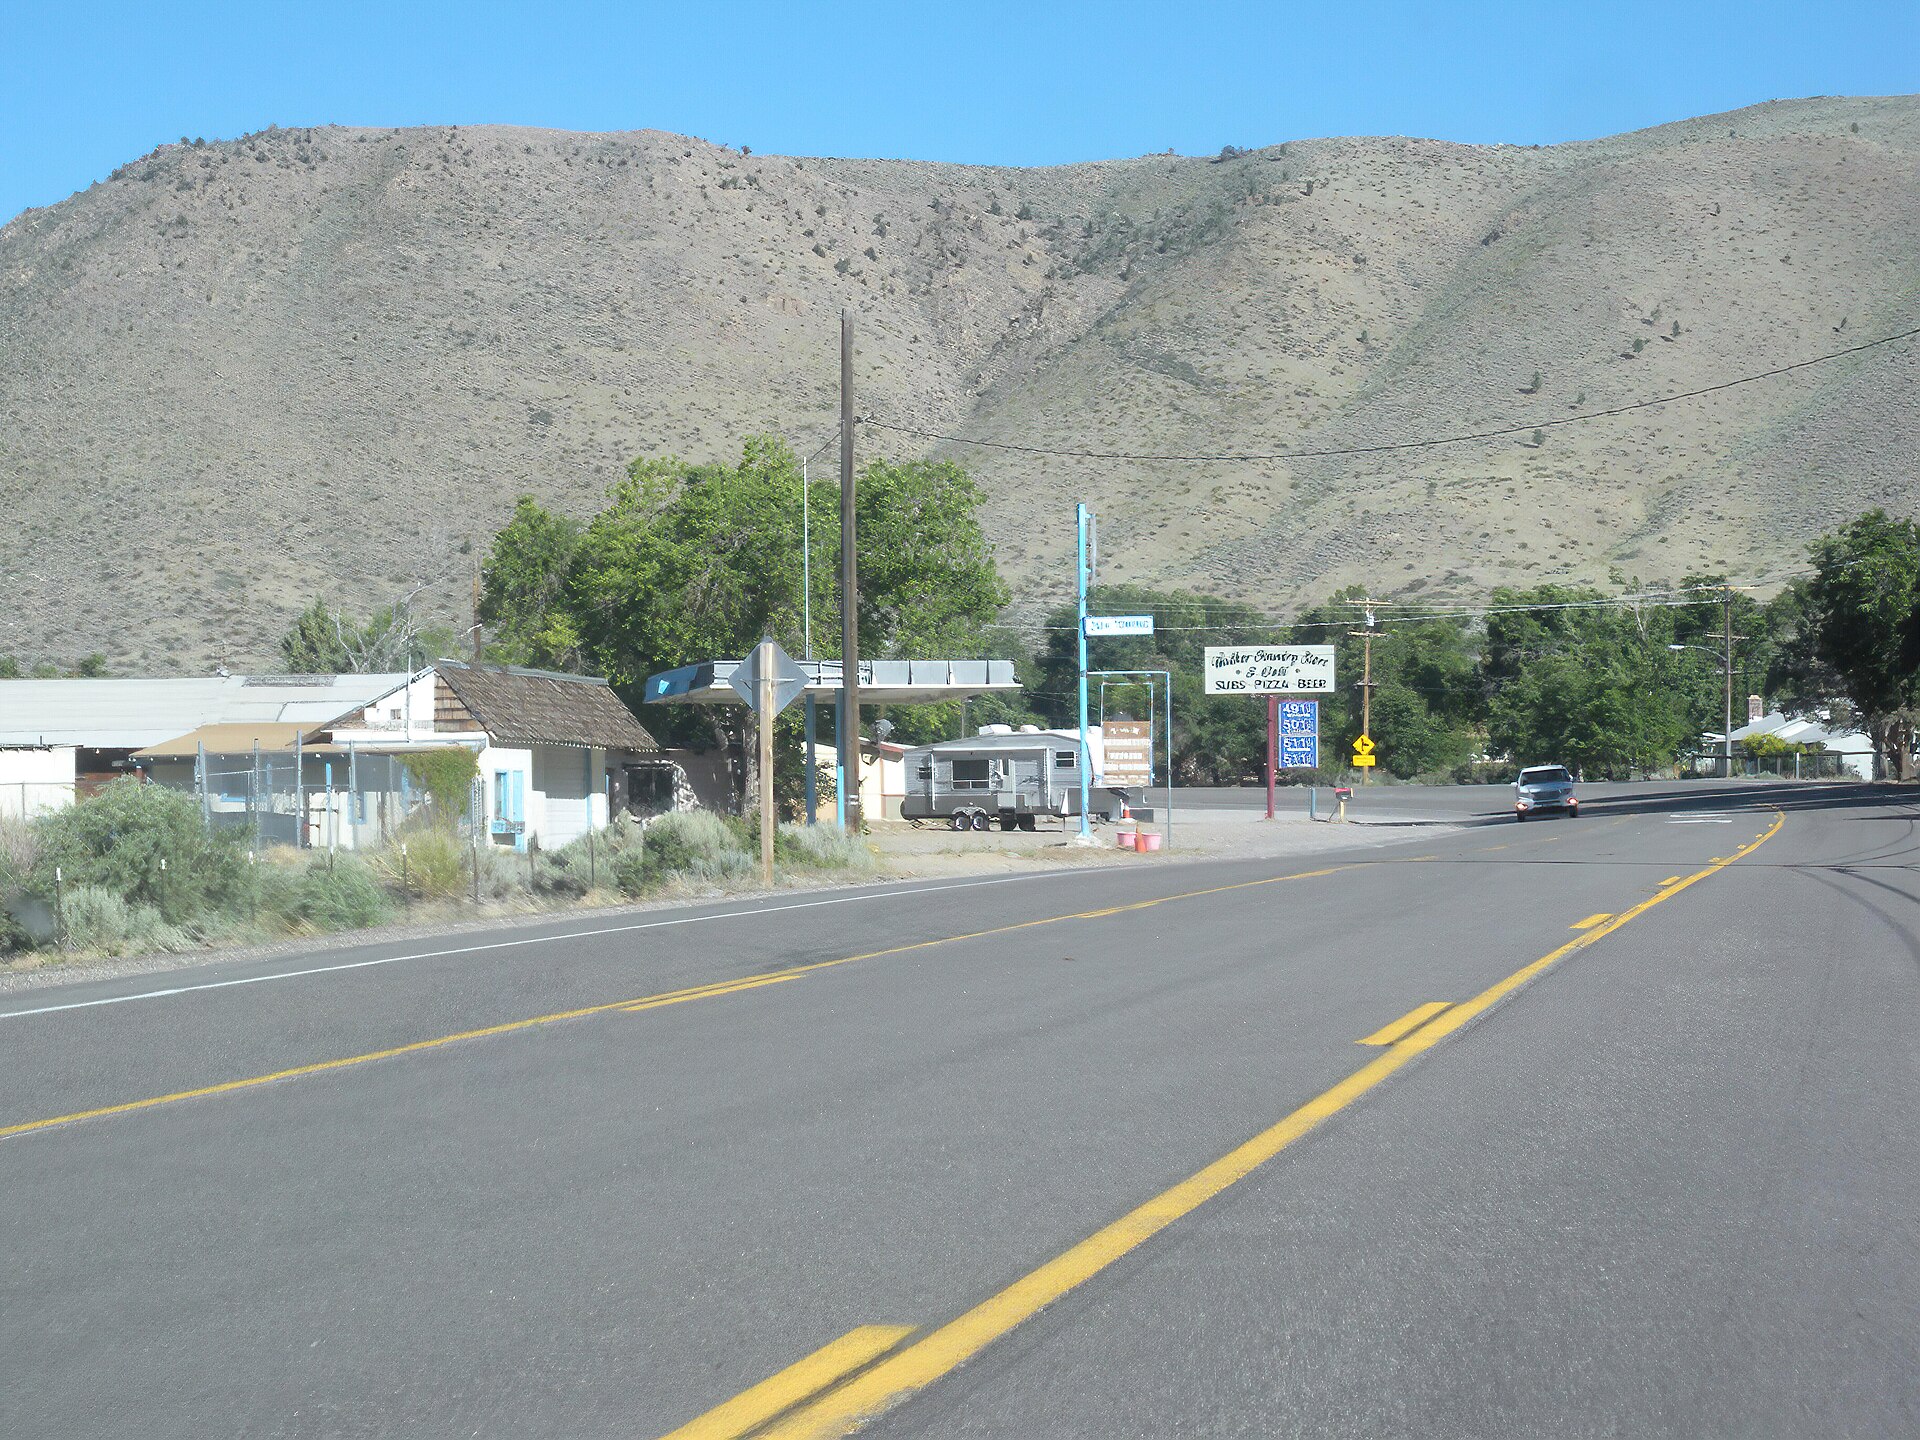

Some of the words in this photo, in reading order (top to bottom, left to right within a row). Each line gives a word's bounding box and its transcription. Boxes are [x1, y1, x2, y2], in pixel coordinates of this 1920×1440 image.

[1215, 680, 1246, 690] SUBS
[1254, 680, 1289, 690] PIZZA
[1298, 679, 1327, 689] BEER
